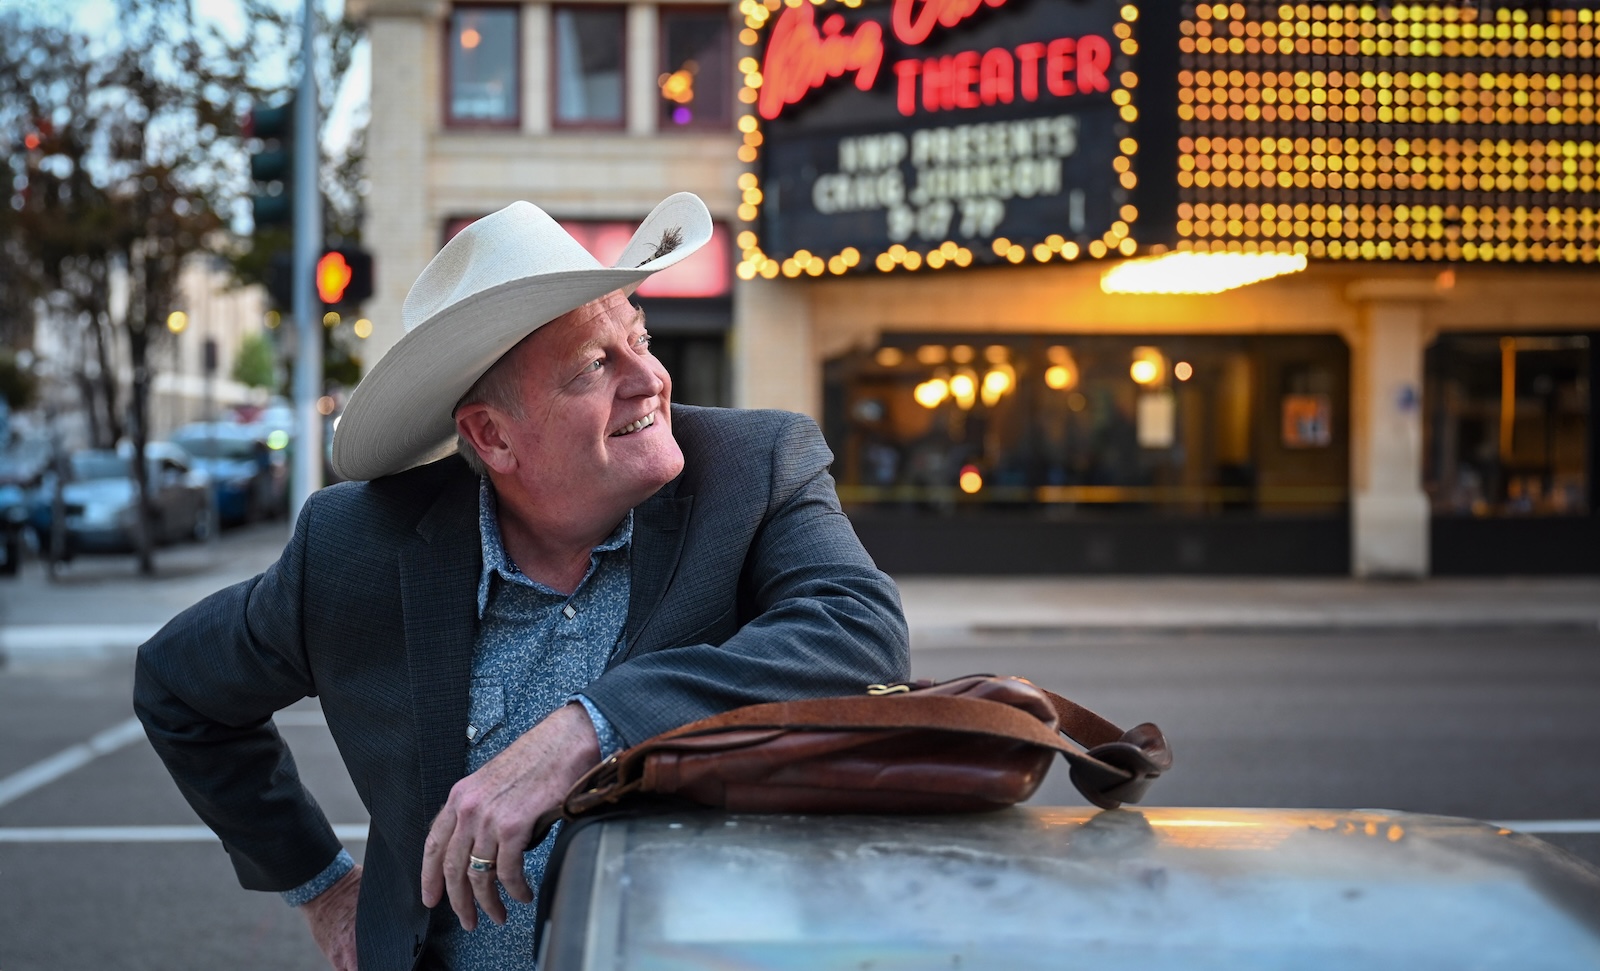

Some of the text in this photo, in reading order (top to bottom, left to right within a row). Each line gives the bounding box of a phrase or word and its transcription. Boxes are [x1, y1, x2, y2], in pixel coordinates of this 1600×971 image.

[892, 34, 1112, 116] THEATER
[912, 115, 1075, 168] PRESENTS
[812, 159, 1061, 213] CRAIG JOHNSON
